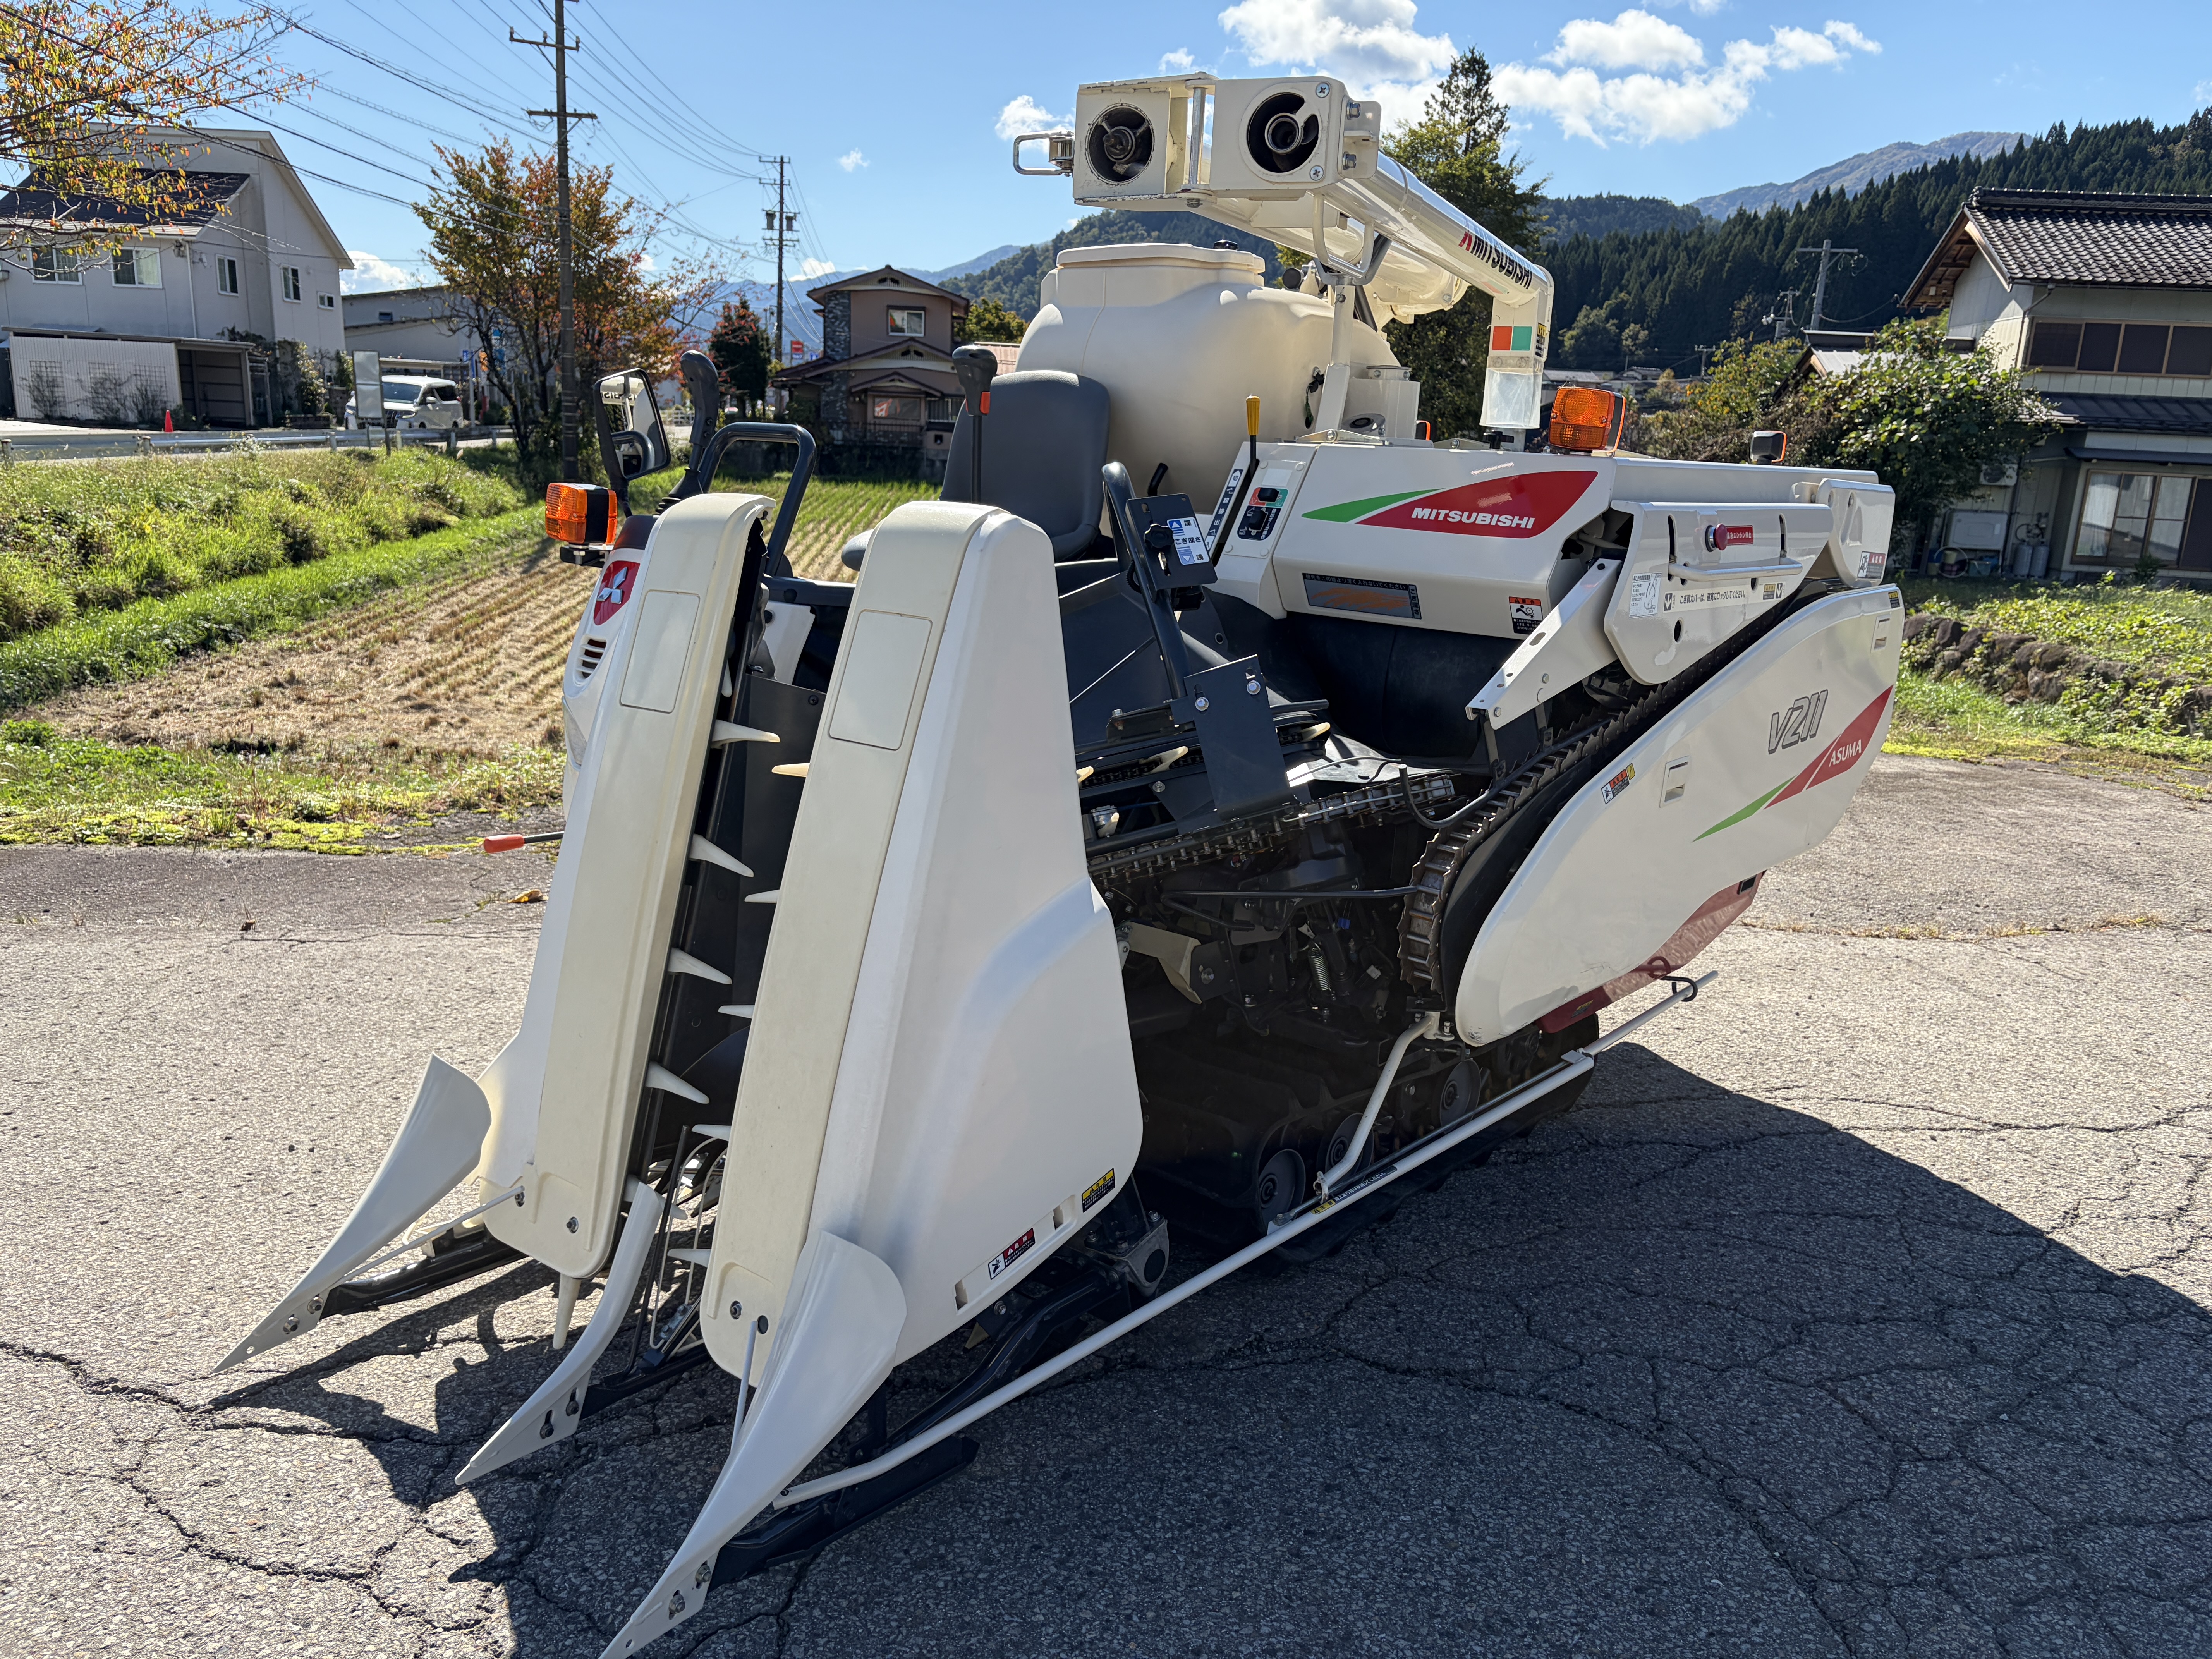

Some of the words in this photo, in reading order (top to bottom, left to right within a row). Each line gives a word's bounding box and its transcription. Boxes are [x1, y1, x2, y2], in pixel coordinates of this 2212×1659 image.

[1470, 234, 1532, 290] MITSUBISHI
[1411, 508, 1535, 529] MITSUBISHI
[1175, 536, 1201, 545] こぎ深さ
[1768, 689, 1828, 754] V211
[1829, 739, 1862, 767] ASUMA
